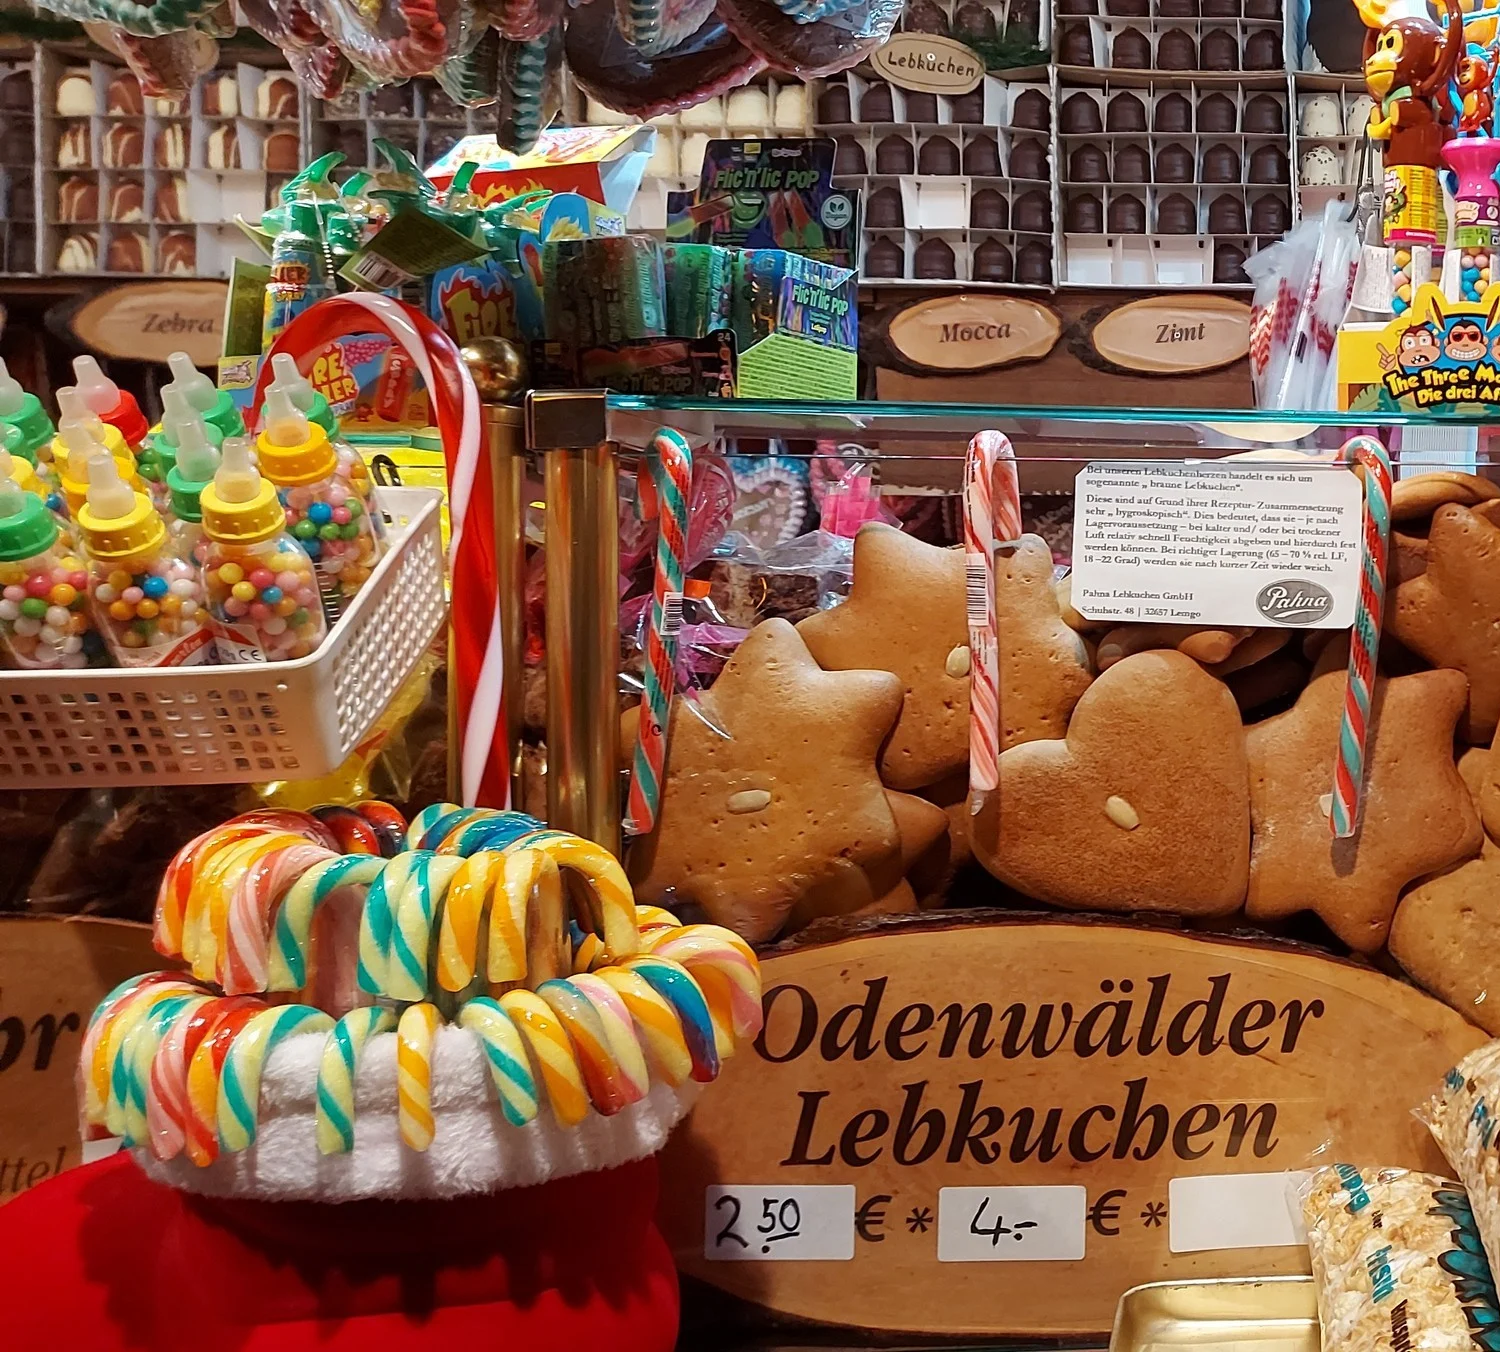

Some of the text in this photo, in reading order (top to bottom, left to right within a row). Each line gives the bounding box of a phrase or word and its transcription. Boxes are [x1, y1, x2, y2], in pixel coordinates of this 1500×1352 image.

[887, 50, 976, 78] Lebkuchen
[785, 170, 820, 189] POP
[831, 297, 849, 317] POP
[142, 311, 214, 334] Zebra
[717, 332, 731, 342] 24
[939, 323, 1011, 344] Mocca
[1156, 323, 1206, 344] Zimt
[1386, 373, 1419, 397] The
[1422, 368, 1470, 387] Three
[1417, 385, 1443, 404] Die
[1445, 384, 1477, 401] drei
[1086, 464, 1102, 474] Bei
[1104, 465, 1142, 475] unseren
[1229, 469, 1262, 480] handelt
[1277, 474, 1295, 482] sich
[1086, 479, 1140, 489] sogenannte
[1150, 479, 1182, 489] braune
[1086, 494, 1113, 503] Diese
[1115, 495, 1135, 504] sind
[1137, 496, 1154, 505] auf
[1155, 496, 1184, 506] Grund
[1186, 497, 1208, 507] ihrer
[1086, 506, 1106, 515] sehr
[1193, 511, 1214, 520] Dies
[1260, 513, 1281, 522] dass
[1283, 514, 1296, 523] sie
[1306, 514, 1314, 525] je
[1316, 516, 1338, 524] nach
[1188, 522, 1203, 532] bei
[1205, 523, 1231, 532] kalter
[1259, 525, 1280, 534] oder
[1281, 526, 1296, 535] bei
[1298, 528, 1341, 536] trockener
[1085, 530, 1356, 549] Luft relativ schnell Feuchtigkeit abgeben und hierdurch fest
[1084, 543, 1118, 552] werden
[1160, 545, 1176, 554] Bei
[1178, 546, 1218, 557] richtiger
[1220, 547, 1264, 560] Lagerung
[1302, 550, 1311, 559] %
[1114, 555, 1141, 567] Grad)
[1143, 558, 1177, 566] werden
[1179, 558, 1193, 567] sie
[1195, 559, 1217, 568] nach
[1219, 560, 1249, 569] kurzer
[1250, 561, 1269, 569] Zeit
[1271, 561, 1302, 570] wieder
[1304, 563, 1333, 572] weich.
[1083, 589, 1193, 601] Pahna Lebkuchen GmbH
[1261, 586, 1329, 612] Pahna
[1081, 606, 1201, 620] Schuhstr. 48 32657 Lemgo
[754, 973, 1325, 1063] Odenwälder
[780, 1076, 1280, 1167] Lebkuchen
[855, 1194, 892, 1243] €
[1087, 1188, 1128, 1238] €
